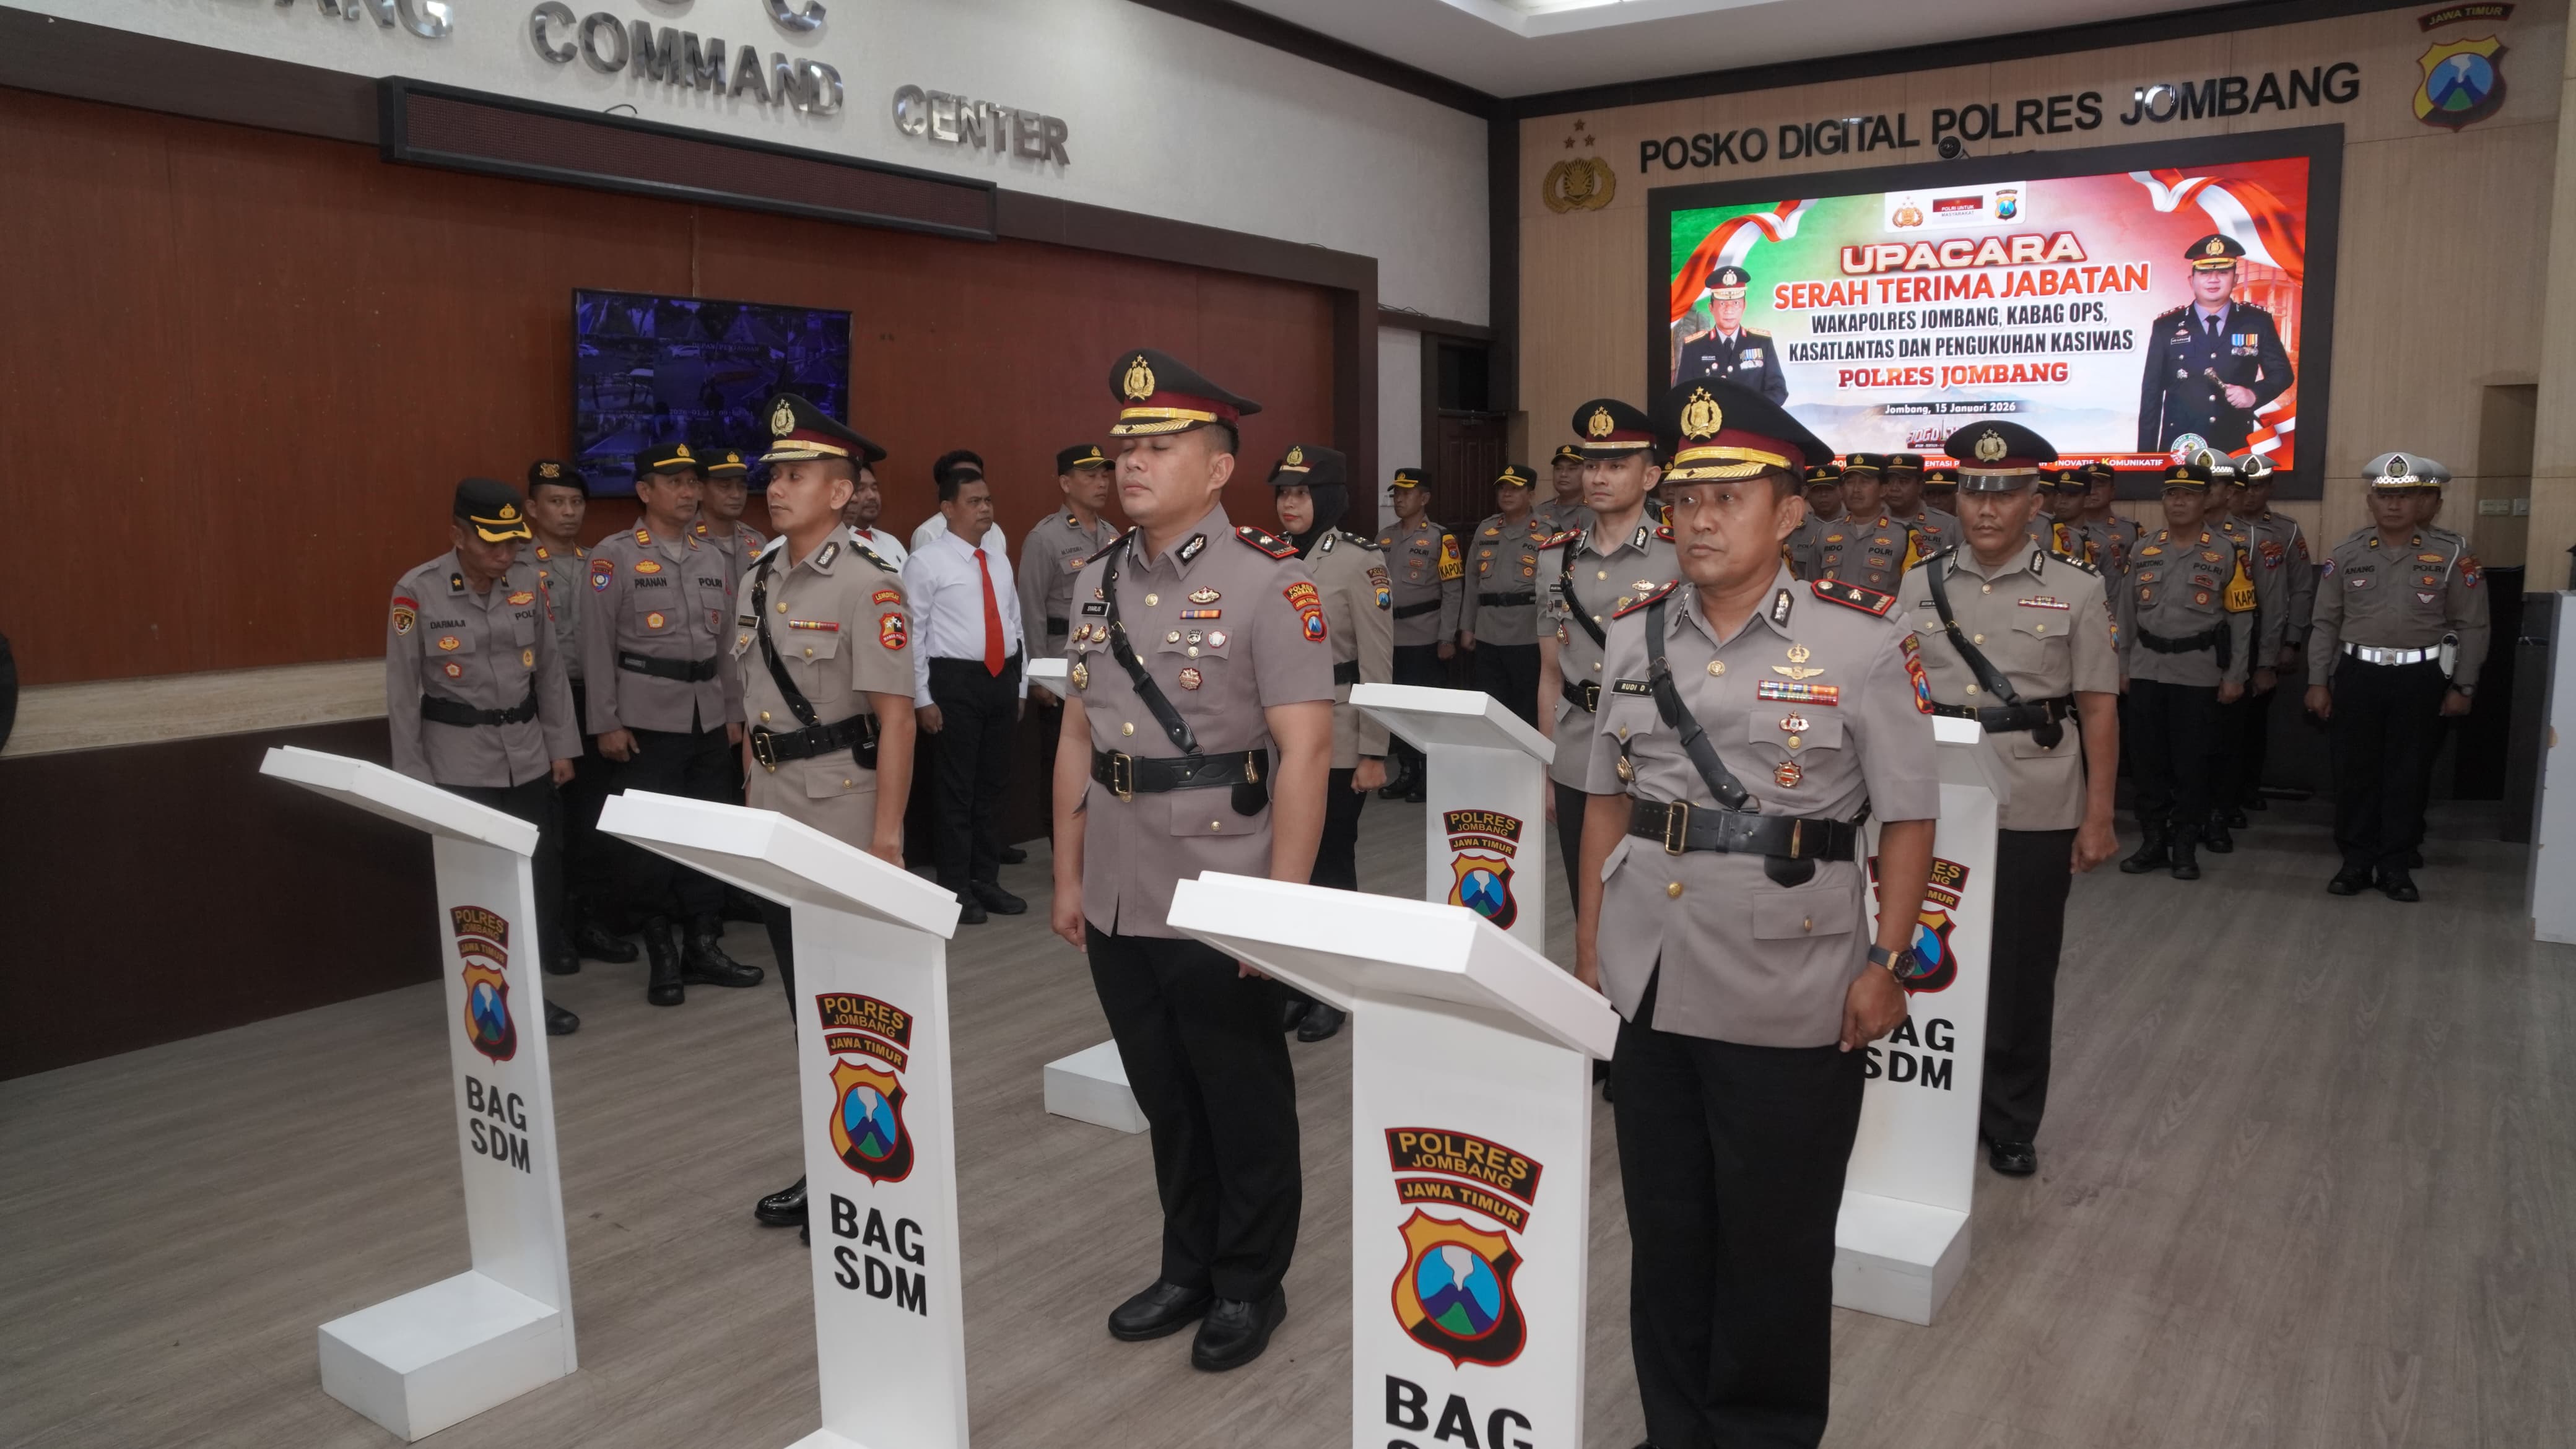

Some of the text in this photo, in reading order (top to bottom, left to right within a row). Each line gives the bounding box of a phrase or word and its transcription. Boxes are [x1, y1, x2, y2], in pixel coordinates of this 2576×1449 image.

[2429, 6, 2503, 25] JAWA TIMUR
[529, 1, 1071, 165] COMMAND CENTER
[1640, 61, 2361, 173] POSKO DIGITAL POLRES JOMBANG
[1841, 231, 2087, 275] UPACARA
[1774, 263, 2149, 309] SERAH TERIMA JABATAN
[1811, 301, 2107, 334] WAKAPOLRES JOMBANG, KABAG OPS,
[1789, 329, 2134, 362] KASATLANTAS DAN PENGUKUHAN KASIWAS
[1838, 362, 2069, 388] POLRES JOMBANG
[1885, 402, 2017, 415] Jombang, 15 Januari 2026
[2102, 458, 2164, 466] KOMUNIKATIF
[1409, 547, 1429, 556] POLRI
[1868, 547, 1893, 556] POLRI
[2193, 562, 2223, 575] POLRI
[2344, 565, 2375, 575] ANANG
[2413, 564, 2445, 573] POLRI
[634, 577, 667, 588] PRANAN
[698, 578, 723, 588] POLRI
[1621, 682, 1637, 691] RUDI
[1450, 812, 1516, 830] POLRES
[1457, 823, 1508, 837] JOMBANG
[1453, 838, 1513, 855] JAWA TIMUR
[455, 908, 505, 933] POLRES
[461, 923, 500, 942] JOMBANG
[461, 942, 505, 964] JAWA TIMUR
[824, 996, 905, 1030] POLRES
[833, 1014, 896, 1038] JOMBANG
[1889, 1014, 1955, 1053] AG
[830, 1036, 903, 1066] JAWA TIMUR
[465, 1075, 528, 1133] BAG
[470, 1118, 531, 1174] SDM
[1398, 1132, 1529, 1180] POLRES
[1412, 1154, 1513, 1190] JOMBANG
[1404, 1183, 1520, 1225] JAWA TIMUR
[830, 1193, 925, 1266] BAG
[834, 1245, 928, 1318] SDM
[1386, 1374, 1533, 1449] BAG
